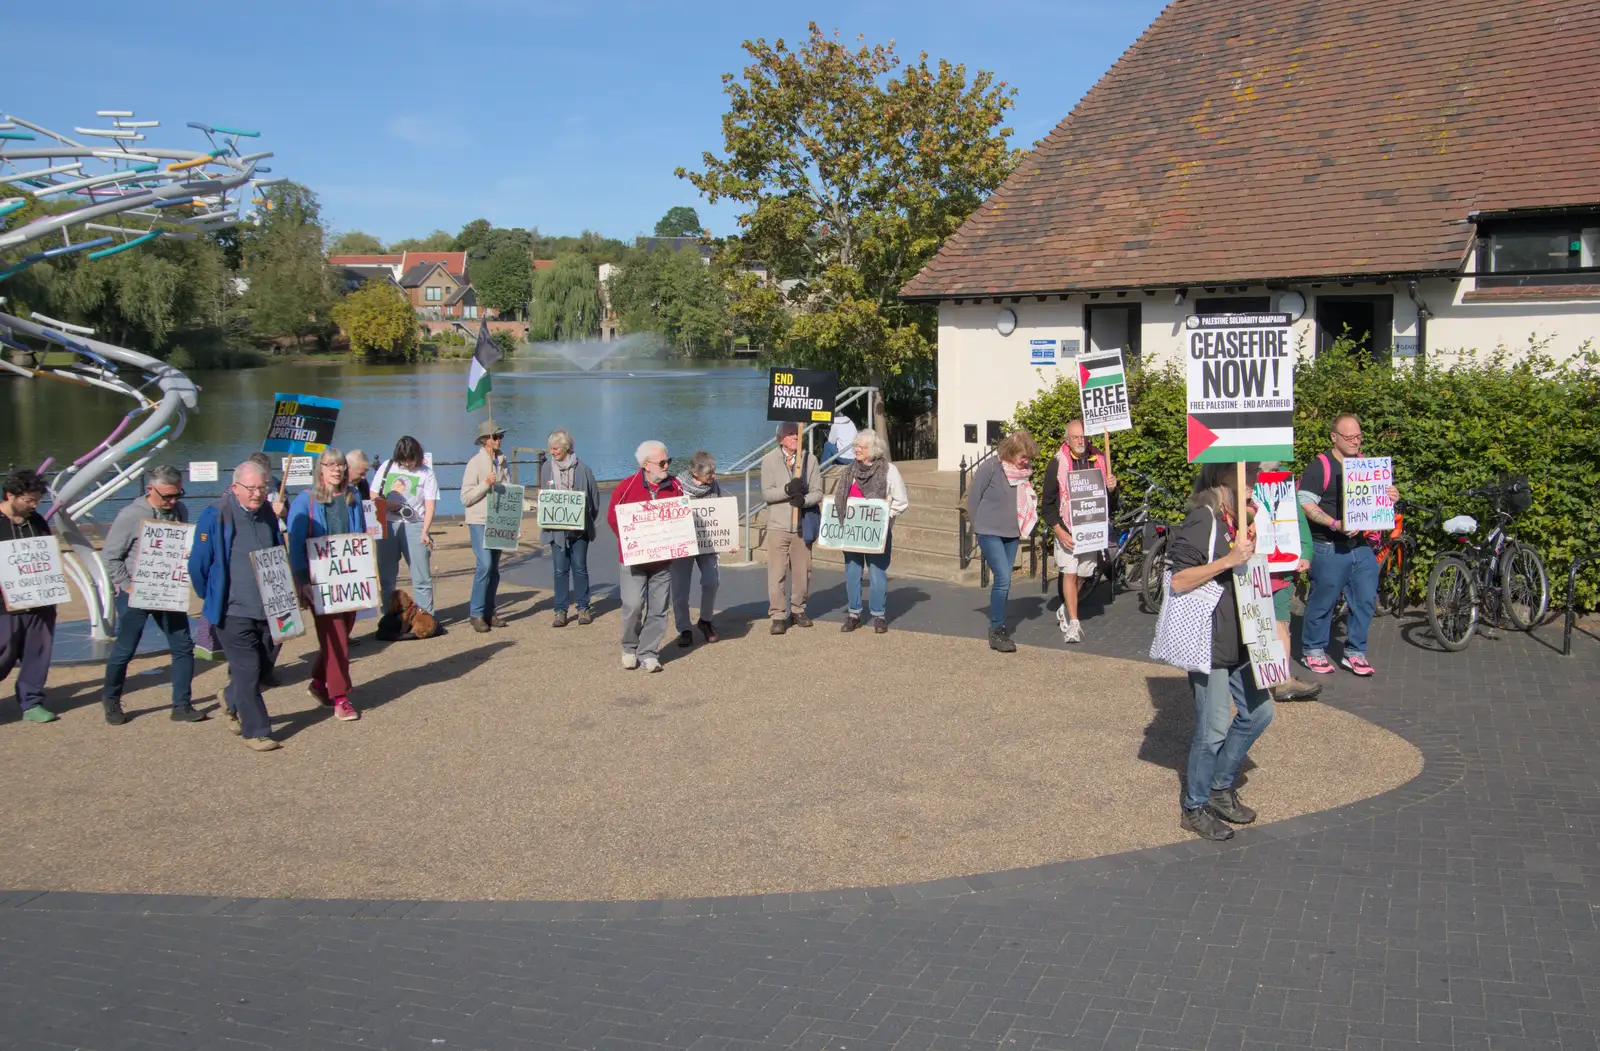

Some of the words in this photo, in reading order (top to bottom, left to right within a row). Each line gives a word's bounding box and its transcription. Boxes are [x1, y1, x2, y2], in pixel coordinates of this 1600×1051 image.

[1202, 317, 1228, 325] PALESTINE
[1228, 316, 1258, 324] SOLIDARITY
[1258, 316, 1286, 324] CAMPAIGN
[1190, 330, 1288, 360] CEASEFIRE
[774, 372, 794, 384] END
[1202, 359, 1280, 398] NOW!
[774, 385, 809, 398] ISRAELI
[1082, 384, 1126, 410] FREE
[278, 401, 298, 416] END
[772, 396, 823, 410] APARTHEID
[1190, 401, 1204, 410] FREE
[1206, 400, 1238, 410] PALESTINE
[1244, 400, 1256, 408] END
[1257, 399, 1290, 408] APARTHEID
[1084, 403, 1127, 419] PALESTINE
[274, 416, 305, 428] ISRAELI
[270, 428, 317, 442] APARTHEID
[1345, 458, 1388, 470] ISRAEL'S
[1348, 470, 1390, 482] KILLED
[1071, 484, 1098, 492] APARTHEID
[1347, 485, 1368, 497] 400
[508, 492, 522, 501] NOT
[540, 493, 582, 505] CEASEFIRE
[1348, 496, 1372, 508] MORE
[1376, 496, 1392, 507] KIDS
[1080, 500, 1096, 508] Free
[543, 506, 584, 523] NOW
[692, 507, 716, 518] TOP
[832, 505, 856, 520] ED
[858, 506, 882, 522] THE
[1072, 506, 1105, 517] Palestine
[1347, 512, 1368, 524] THAN
[1372, 508, 1394, 524] HAMAS
[487, 516, 494, 524] TO
[164, 528, 187, 540] THEY
[485, 528, 516, 540] GENOCIDE
[697, 529, 730, 538] STINIAN
[821, 523, 882, 542] OCCUPATION
[21, 542, 30, 550] IN
[36, 540, 48, 550] 70
[314, 540, 338, 560] WE
[342, 538, 369, 556] ARE
[8, 551, 50, 566] GAZANS
[670, 547, 689, 558] BDS
[255, 549, 287, 570] NEVER
[18, 562, 52, 575] KILLED
[329, 558, 358, 576] ALL
[4, 581, 15, 590] BY
[19, 577, 42, 588] ISRAELI
[44, 574, 66, 584] FORCES
[136, 570, 150, 578] AND
[152, 572, 170, 580] THEY
[172, 570, 190, 582] LIE
[263, 569, 287, 586] AGAIN
[1238, 572, 1252, 586] BAN
[1252, 565, 1271, 600] ALL
[272, 583, 286, 594] FOR
[321, 580, 371, 606] HUMAN
[10, 592, 33, 604] SINCE
[268, 592, 296, 613] ANYONE
[1242, 602, 1260, 620] ARMS
[1257, 618, 1272, 633] SALES
[1258, 634, 1268, 647] TO
[1258, 659, 1287, 686] NOW
